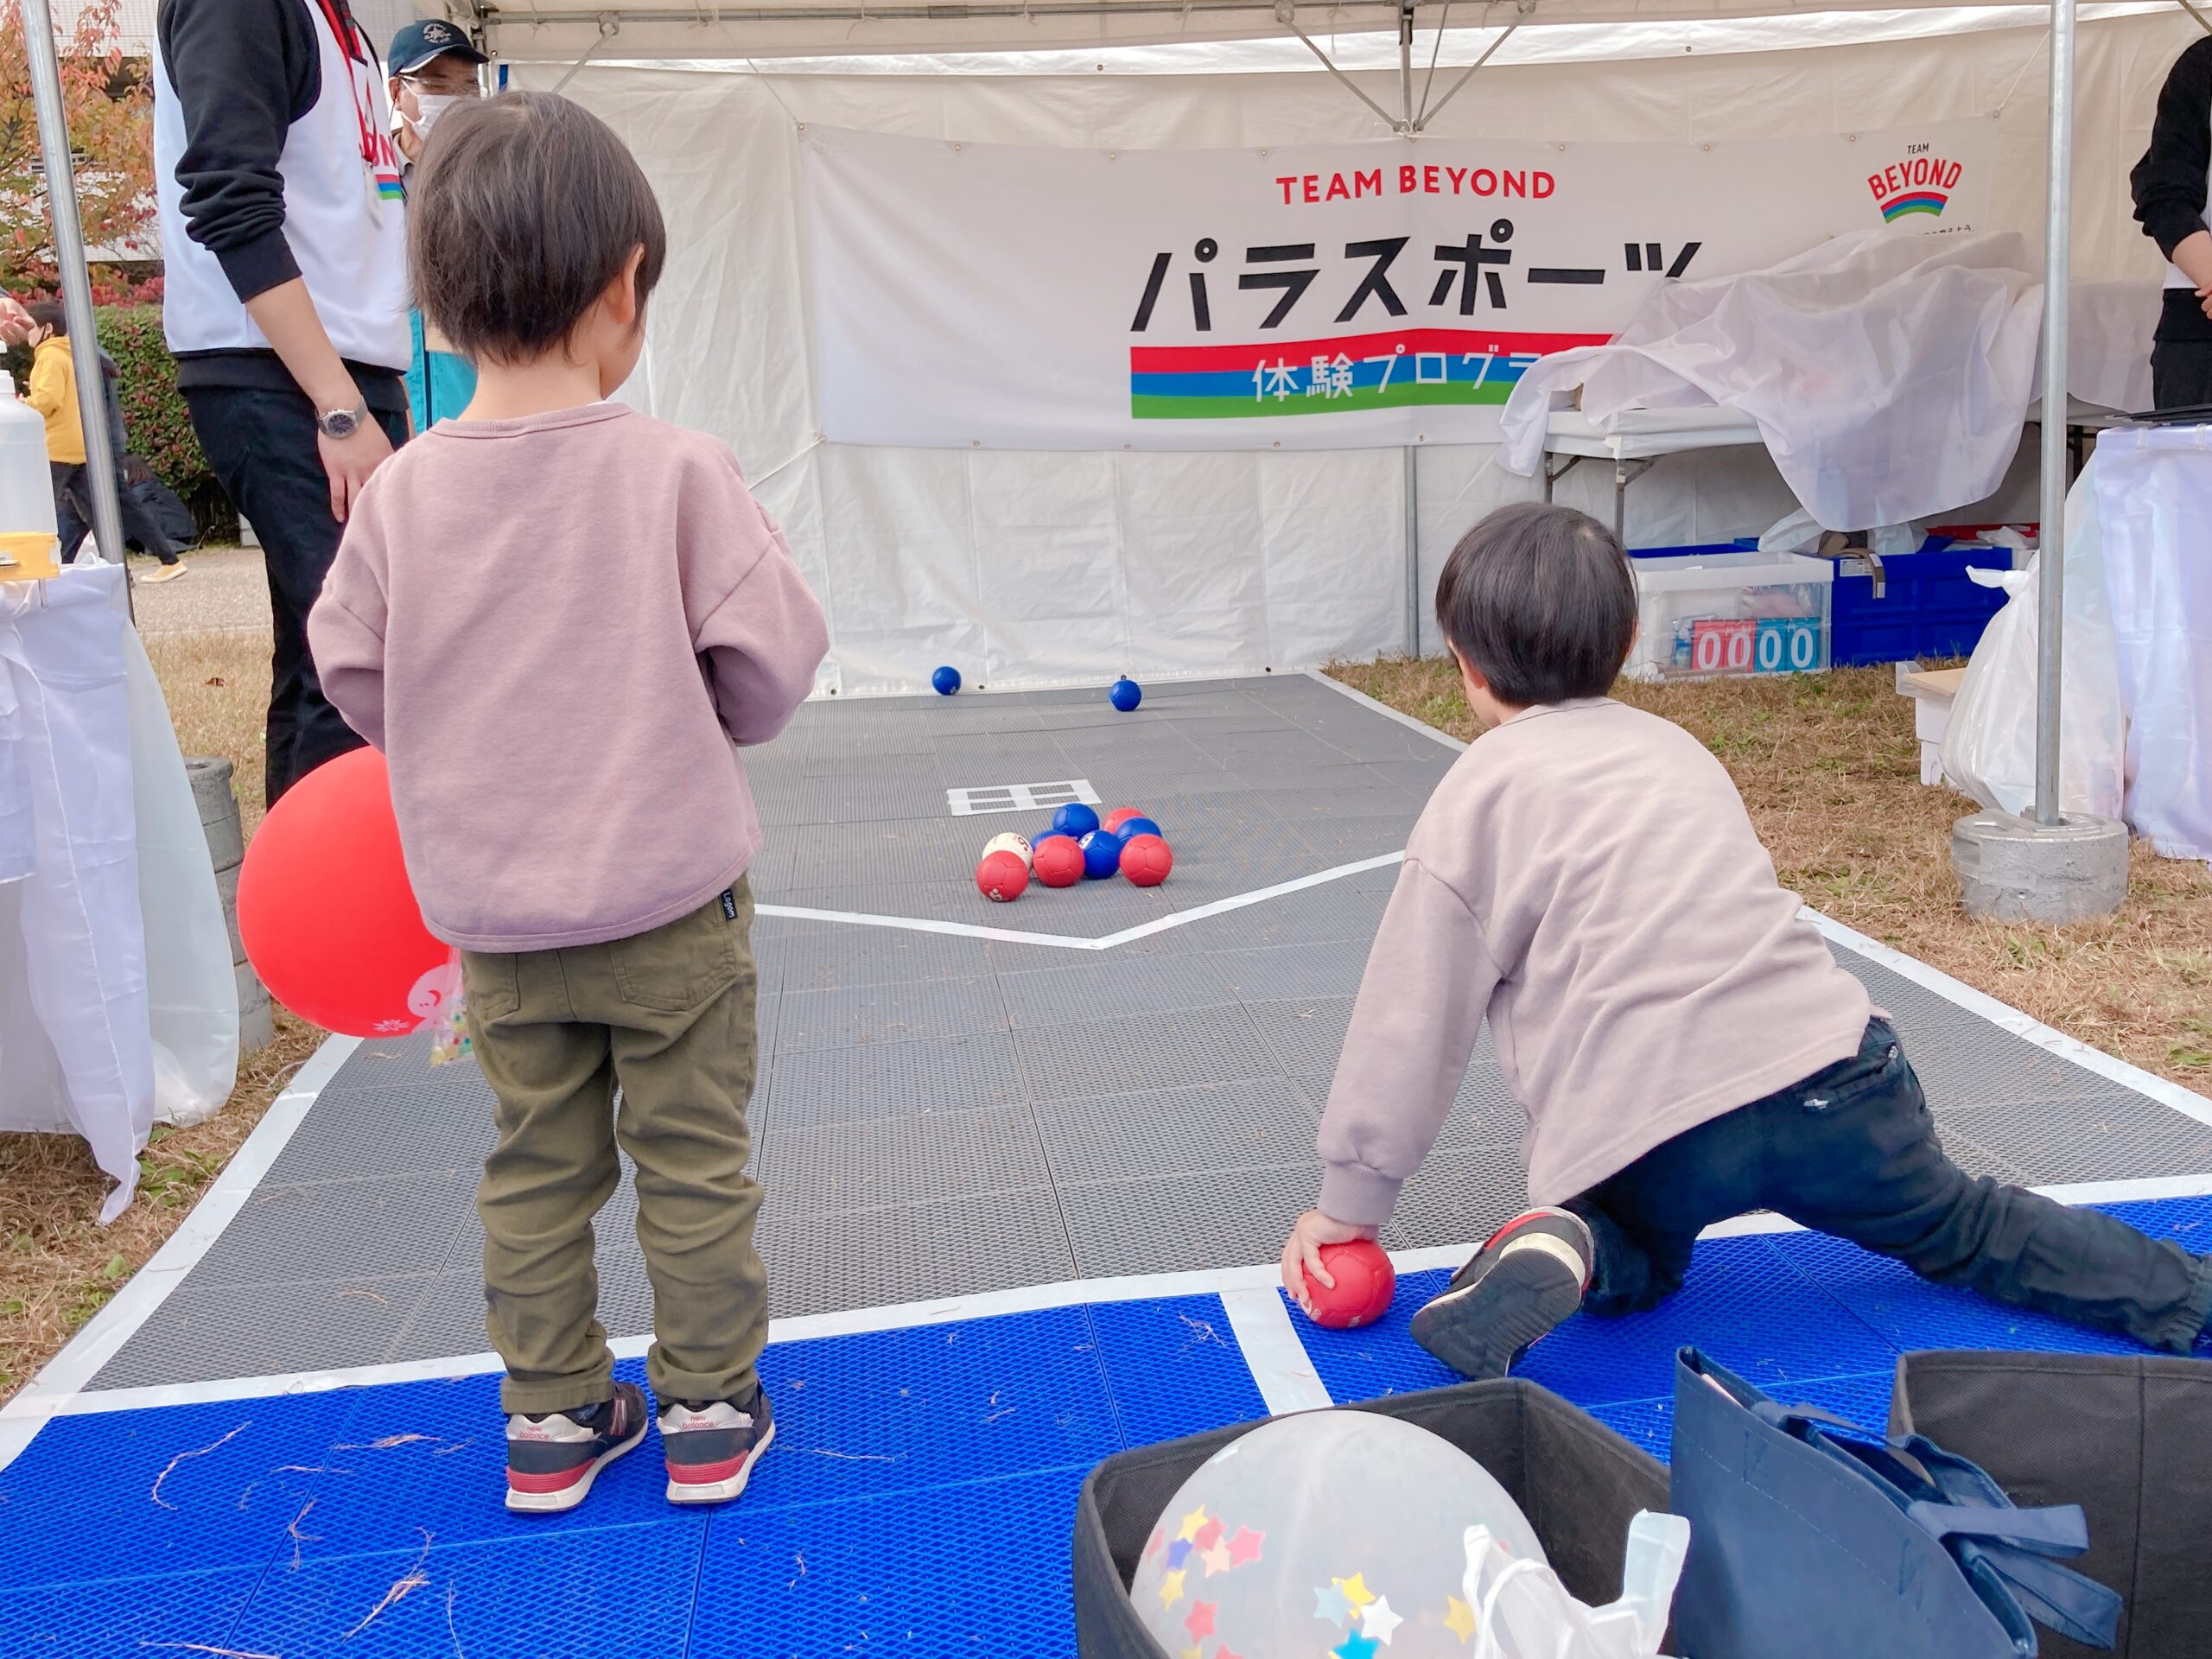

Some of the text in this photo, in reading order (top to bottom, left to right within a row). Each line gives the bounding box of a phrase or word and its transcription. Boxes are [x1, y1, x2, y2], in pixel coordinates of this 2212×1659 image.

[1907, 143, 1929, 155] TEAM
[1275, 165, 1555, 205] TEAM BEYOND
[1867, 158, 1962, 200] BEYOND
[1130, 218, 1703, 332] パラスポーツ
[520, 1431, 550, 1440] balance
[683, 1421, 715, 1429] balance
